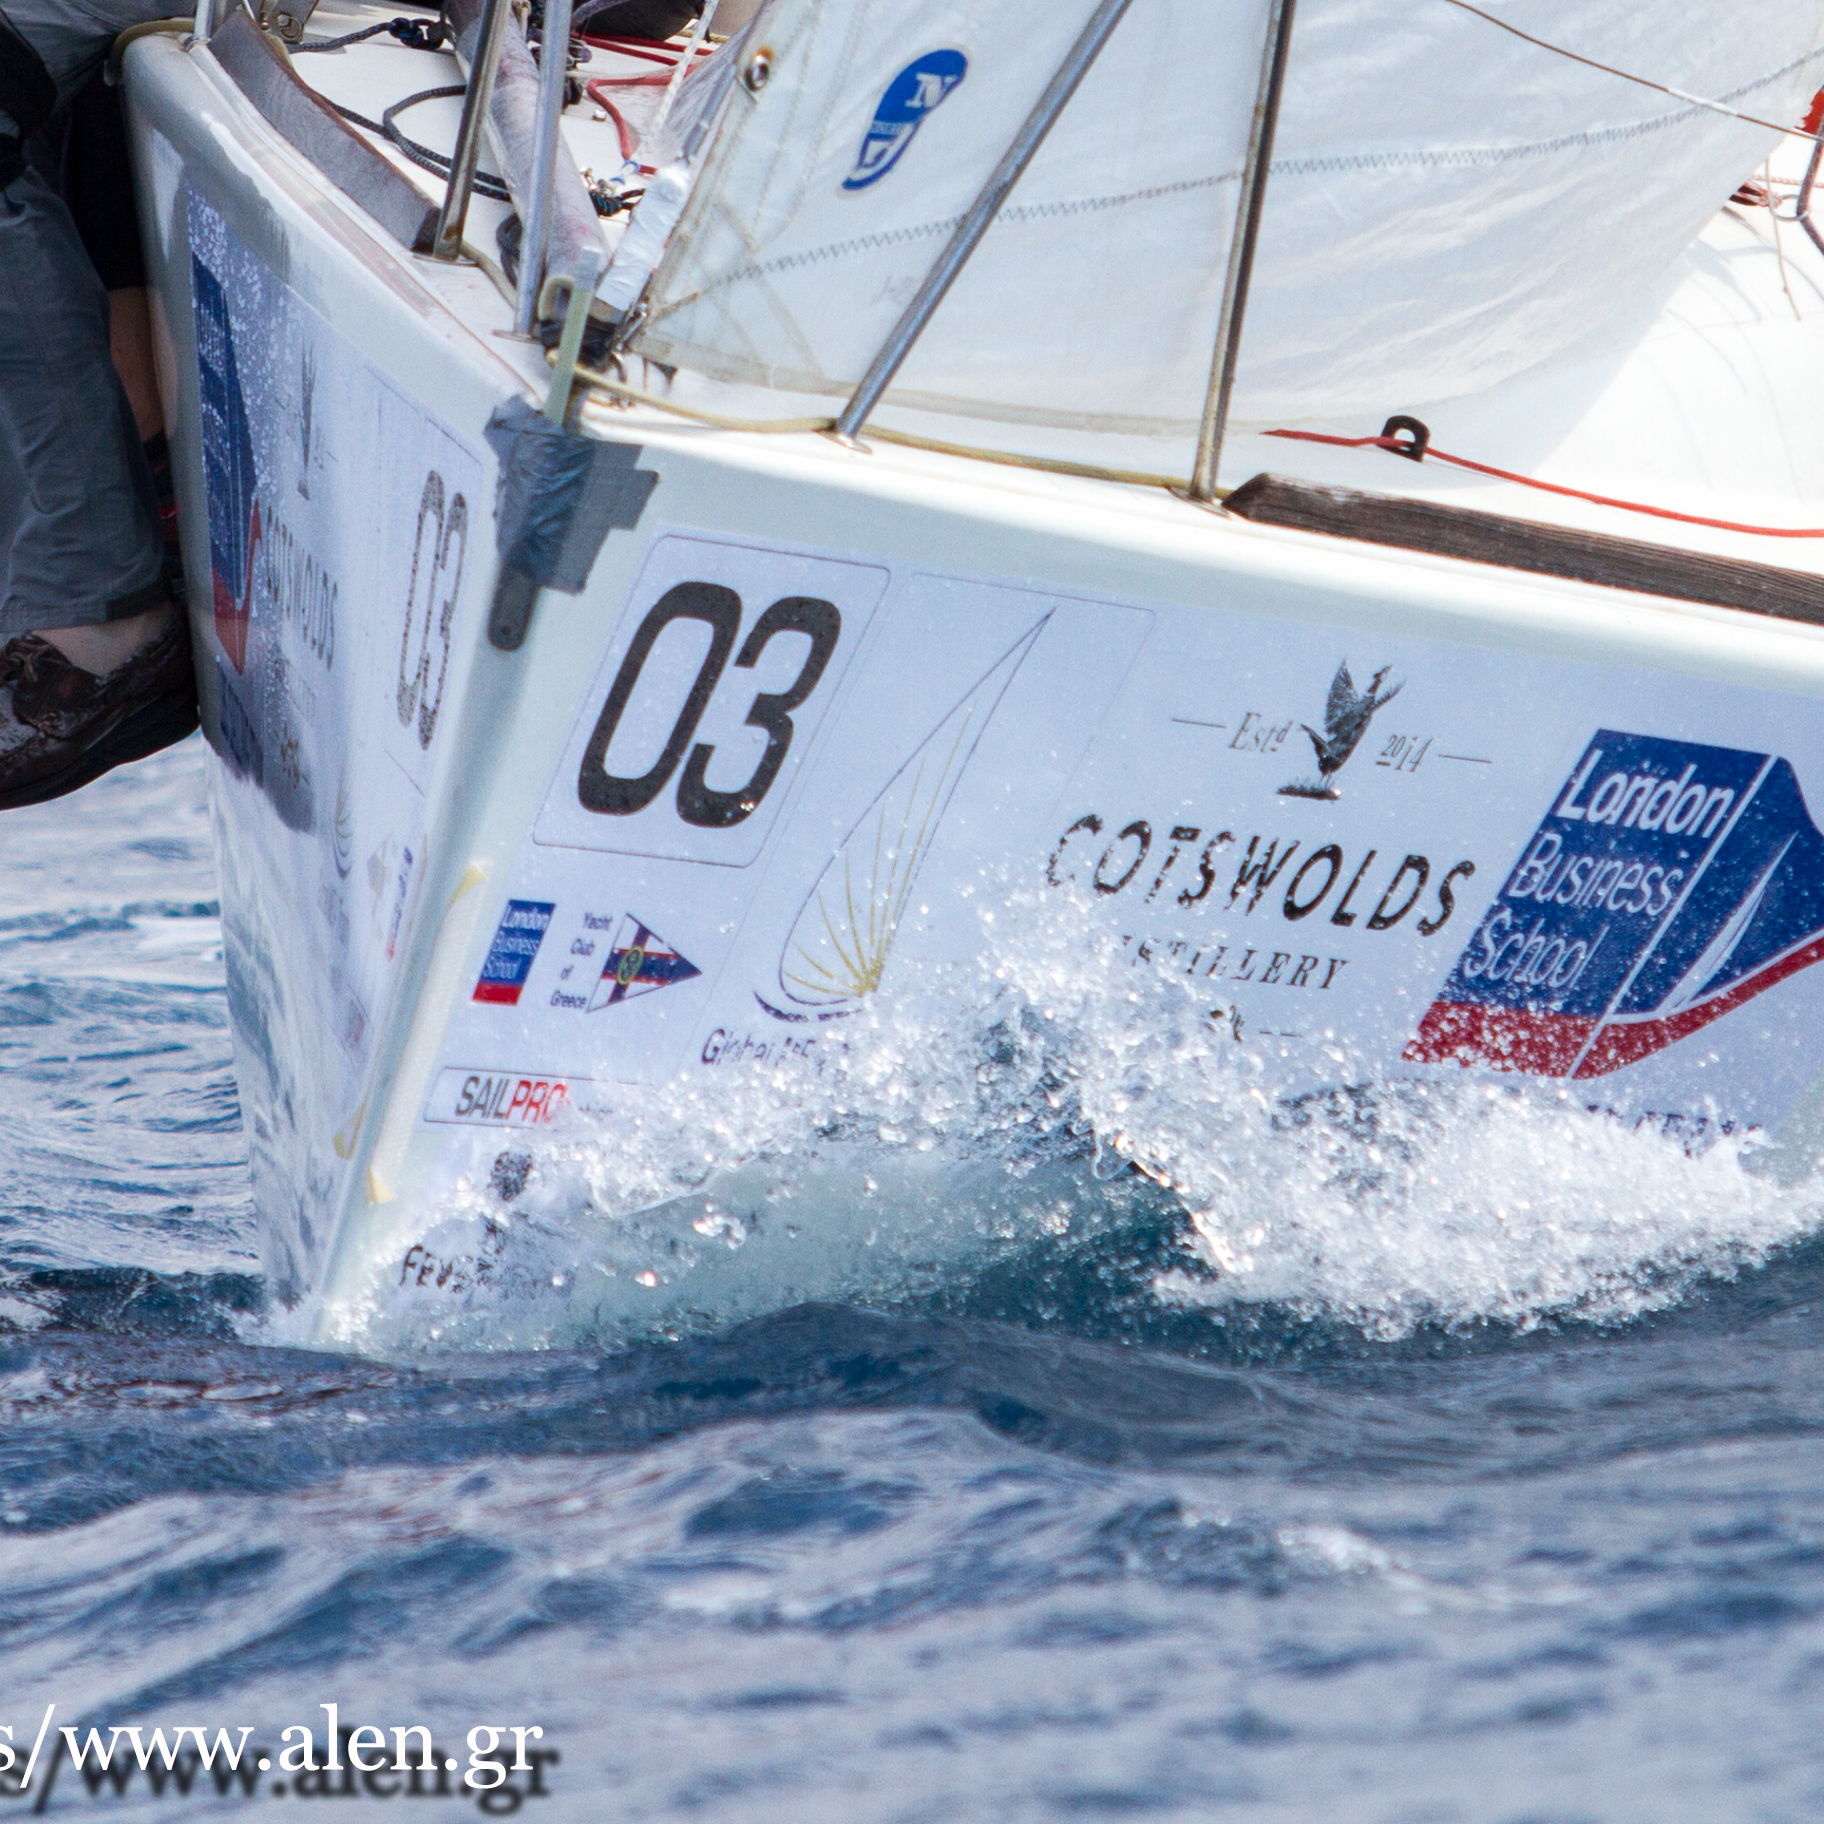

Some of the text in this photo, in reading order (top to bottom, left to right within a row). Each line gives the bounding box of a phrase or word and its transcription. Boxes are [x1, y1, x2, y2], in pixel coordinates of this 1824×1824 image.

[397, 469, 469, 752] 03
[577, 580, 841, 828] 03
[1556, 747, 1736, 839] London
[1046, 813, 1477, 937] COTSWOLDS
[1507, 832, 1685, 916] Business
[1463, 906, 1611, 989] School
[455, 1075, 568, 1124] SAILPRO
